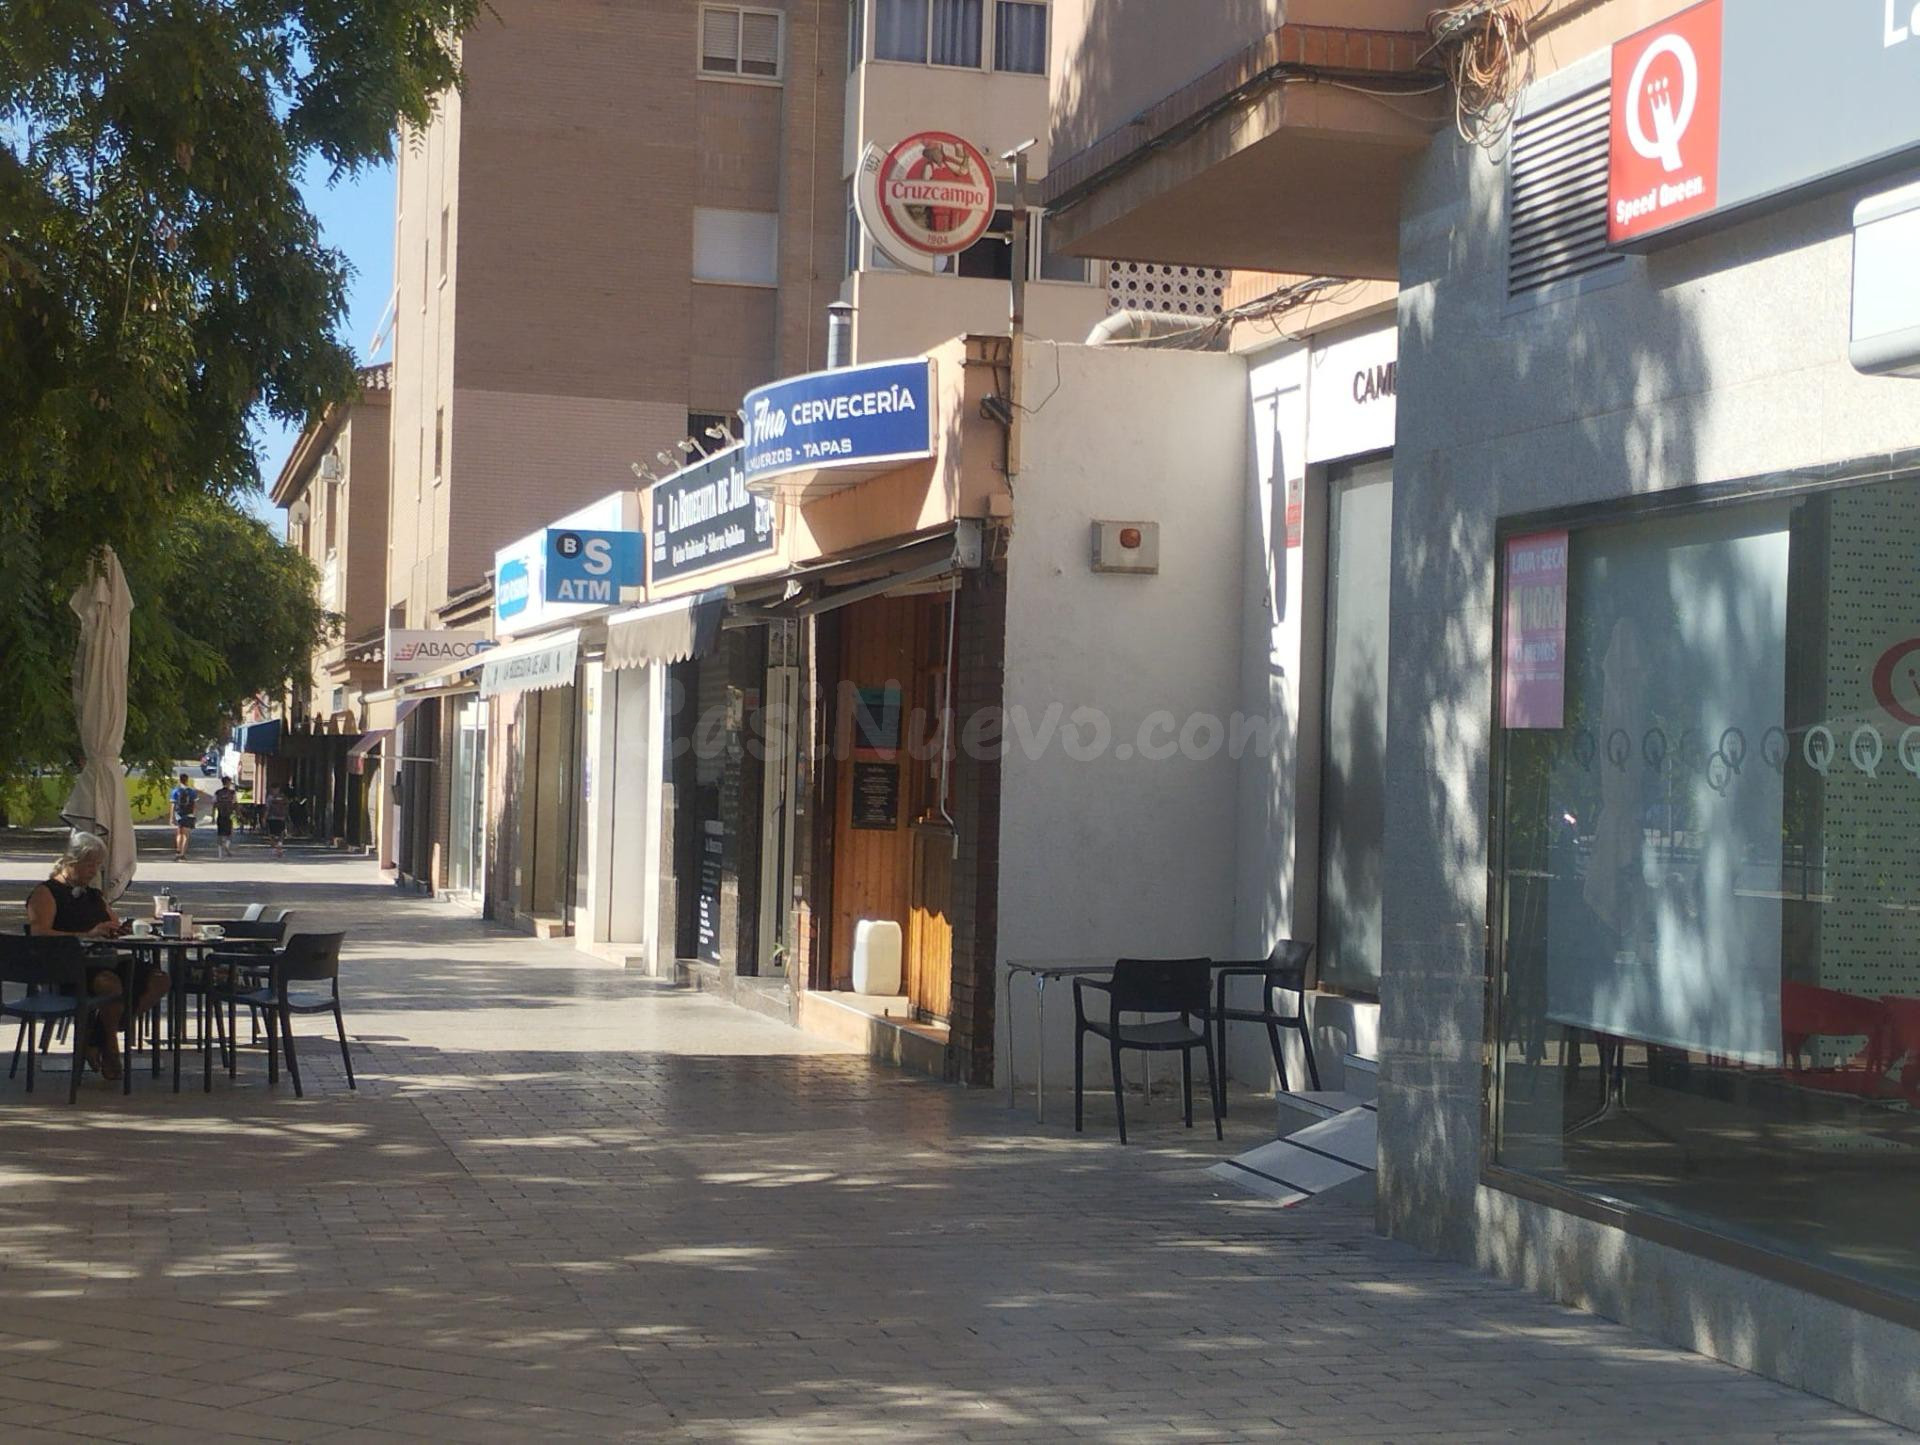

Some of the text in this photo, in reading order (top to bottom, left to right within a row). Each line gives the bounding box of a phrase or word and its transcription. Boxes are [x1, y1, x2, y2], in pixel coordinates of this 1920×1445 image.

[891, 182, 984, 206] Cruzcampo
[1616, 176, 1704, 225] Speed Queen
[791, 384, 916, 427] CERVECERÍA
[803, 438, 853, 459] TAPAS
[557, 579, 612, 601] ATM
